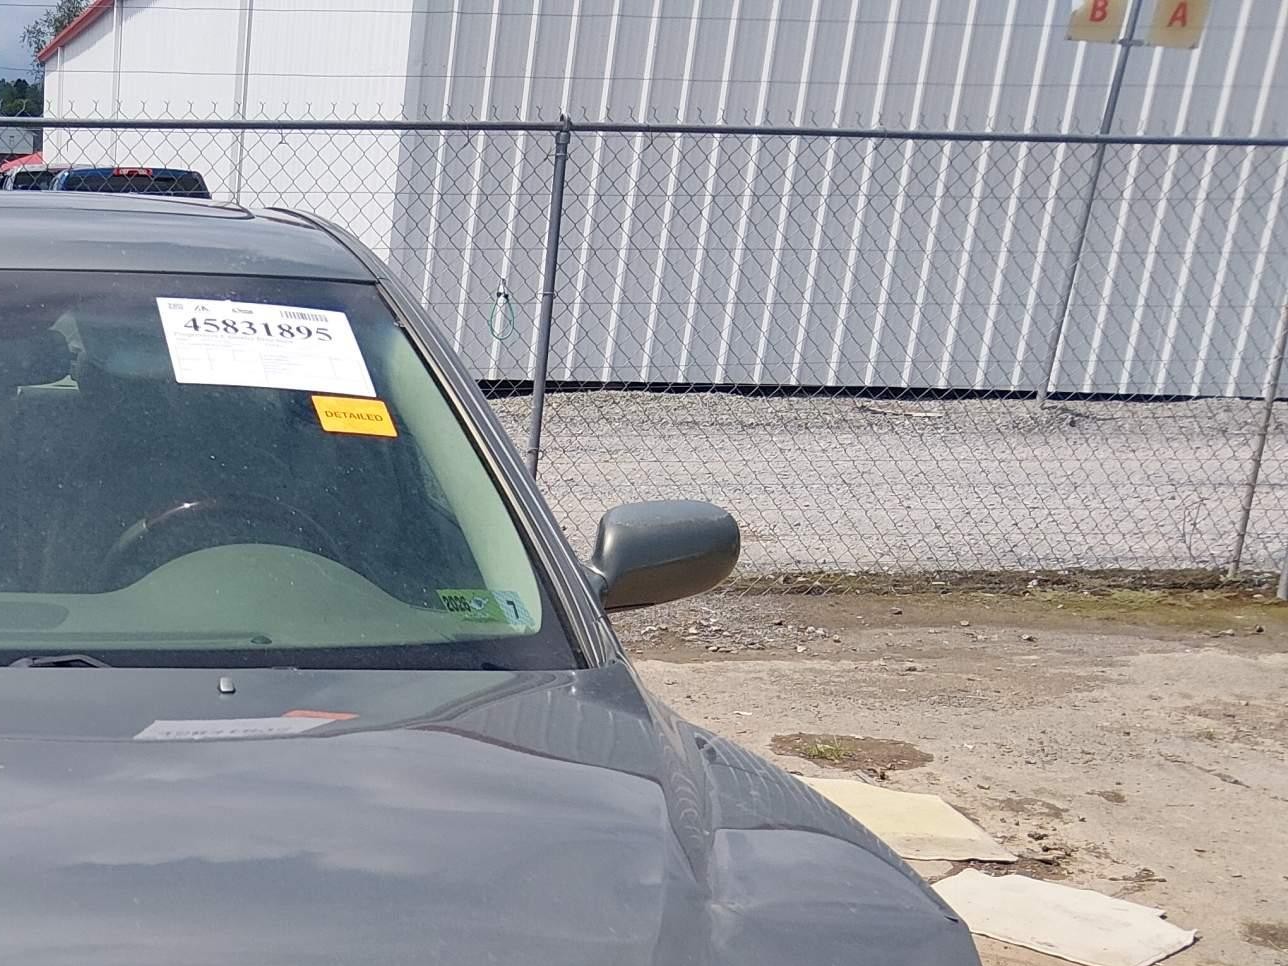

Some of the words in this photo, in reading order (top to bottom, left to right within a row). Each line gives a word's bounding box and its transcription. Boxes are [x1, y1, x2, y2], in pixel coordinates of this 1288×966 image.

[1089, 0, 1109, 22] B
[1167, 2, 1188, 28] A
[183, 317, 333, 342] 45831895
[324, 410, 383, 423] DETAILED
[506, 600, 519, 619] 7
